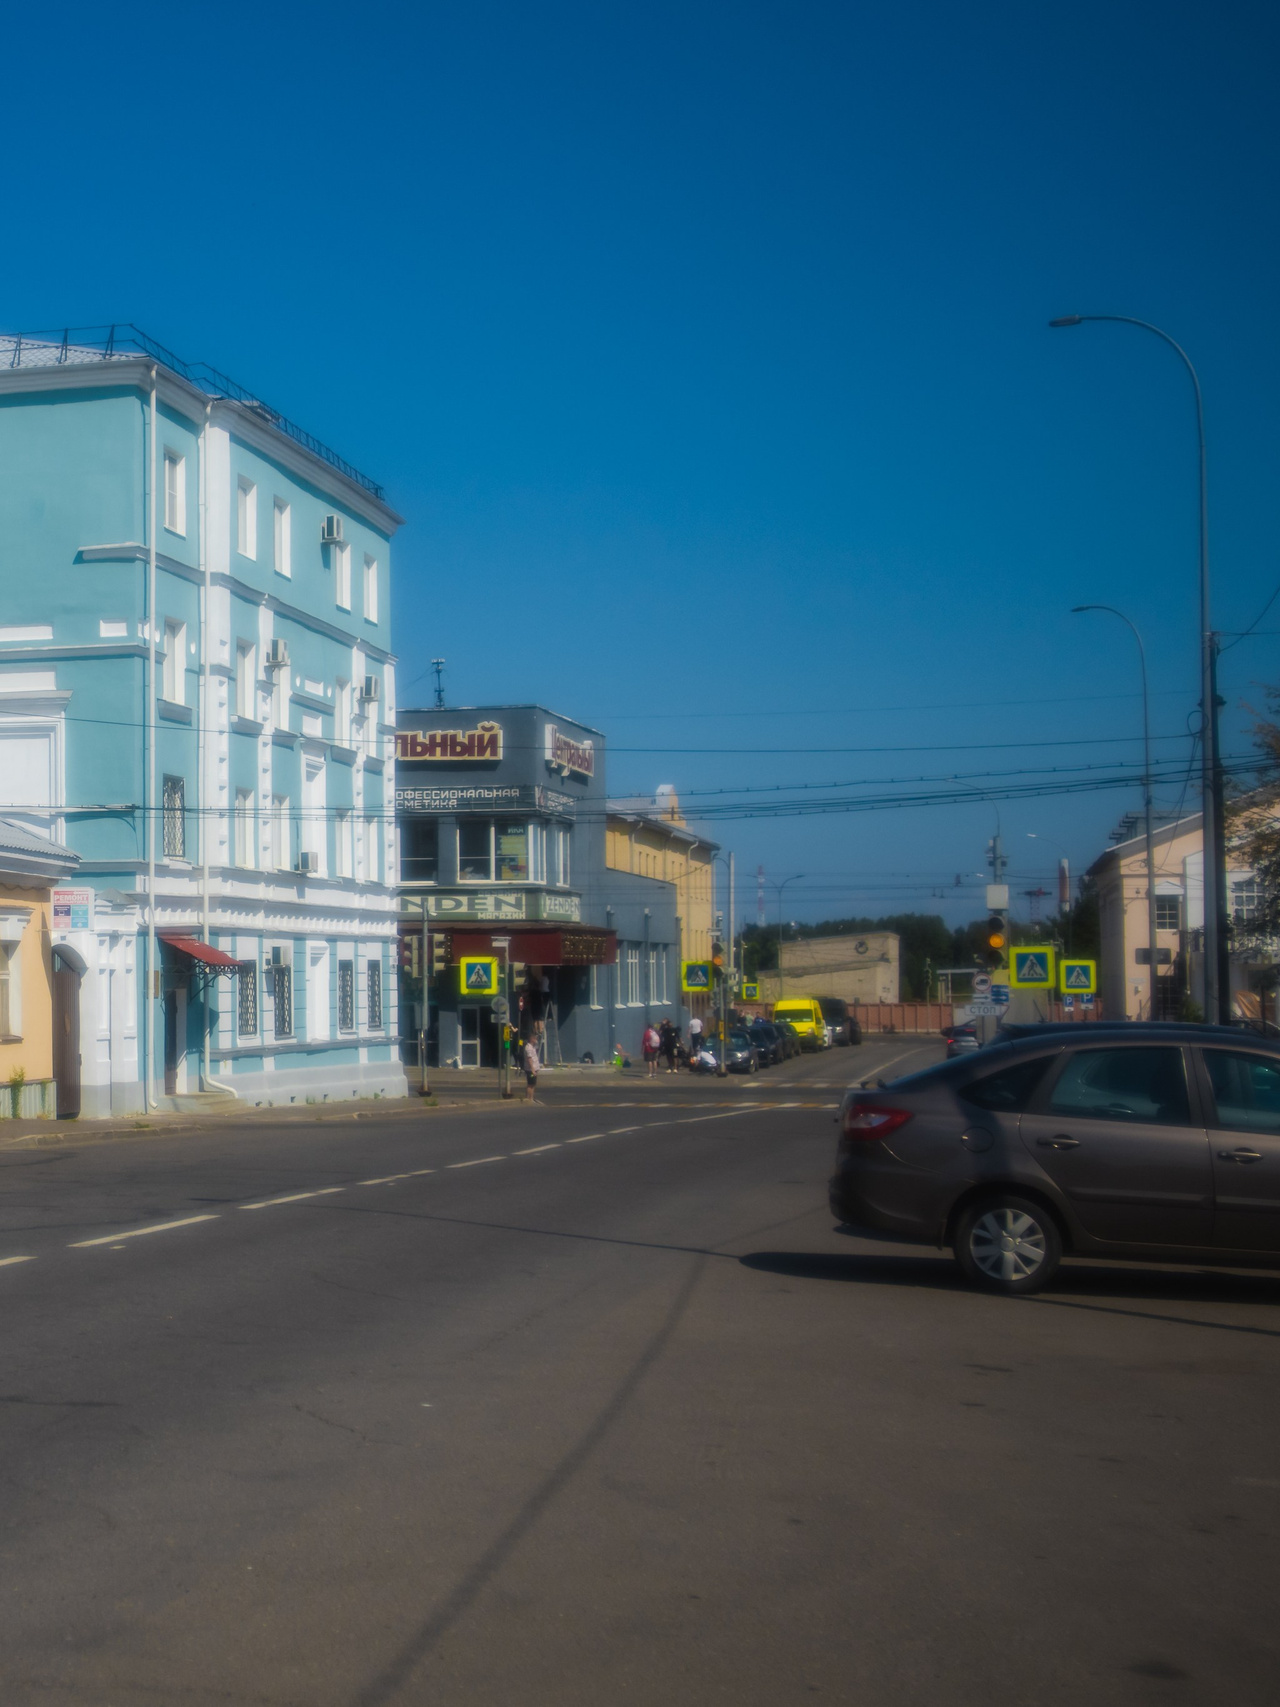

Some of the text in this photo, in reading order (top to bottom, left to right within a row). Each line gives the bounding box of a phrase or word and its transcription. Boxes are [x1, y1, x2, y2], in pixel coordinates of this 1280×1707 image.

[547, 897, 580, 914] ZENDEN
[478, 911, 526, 920] МАГАЗИН
[970, 1005, 996, 1015] СТОП
